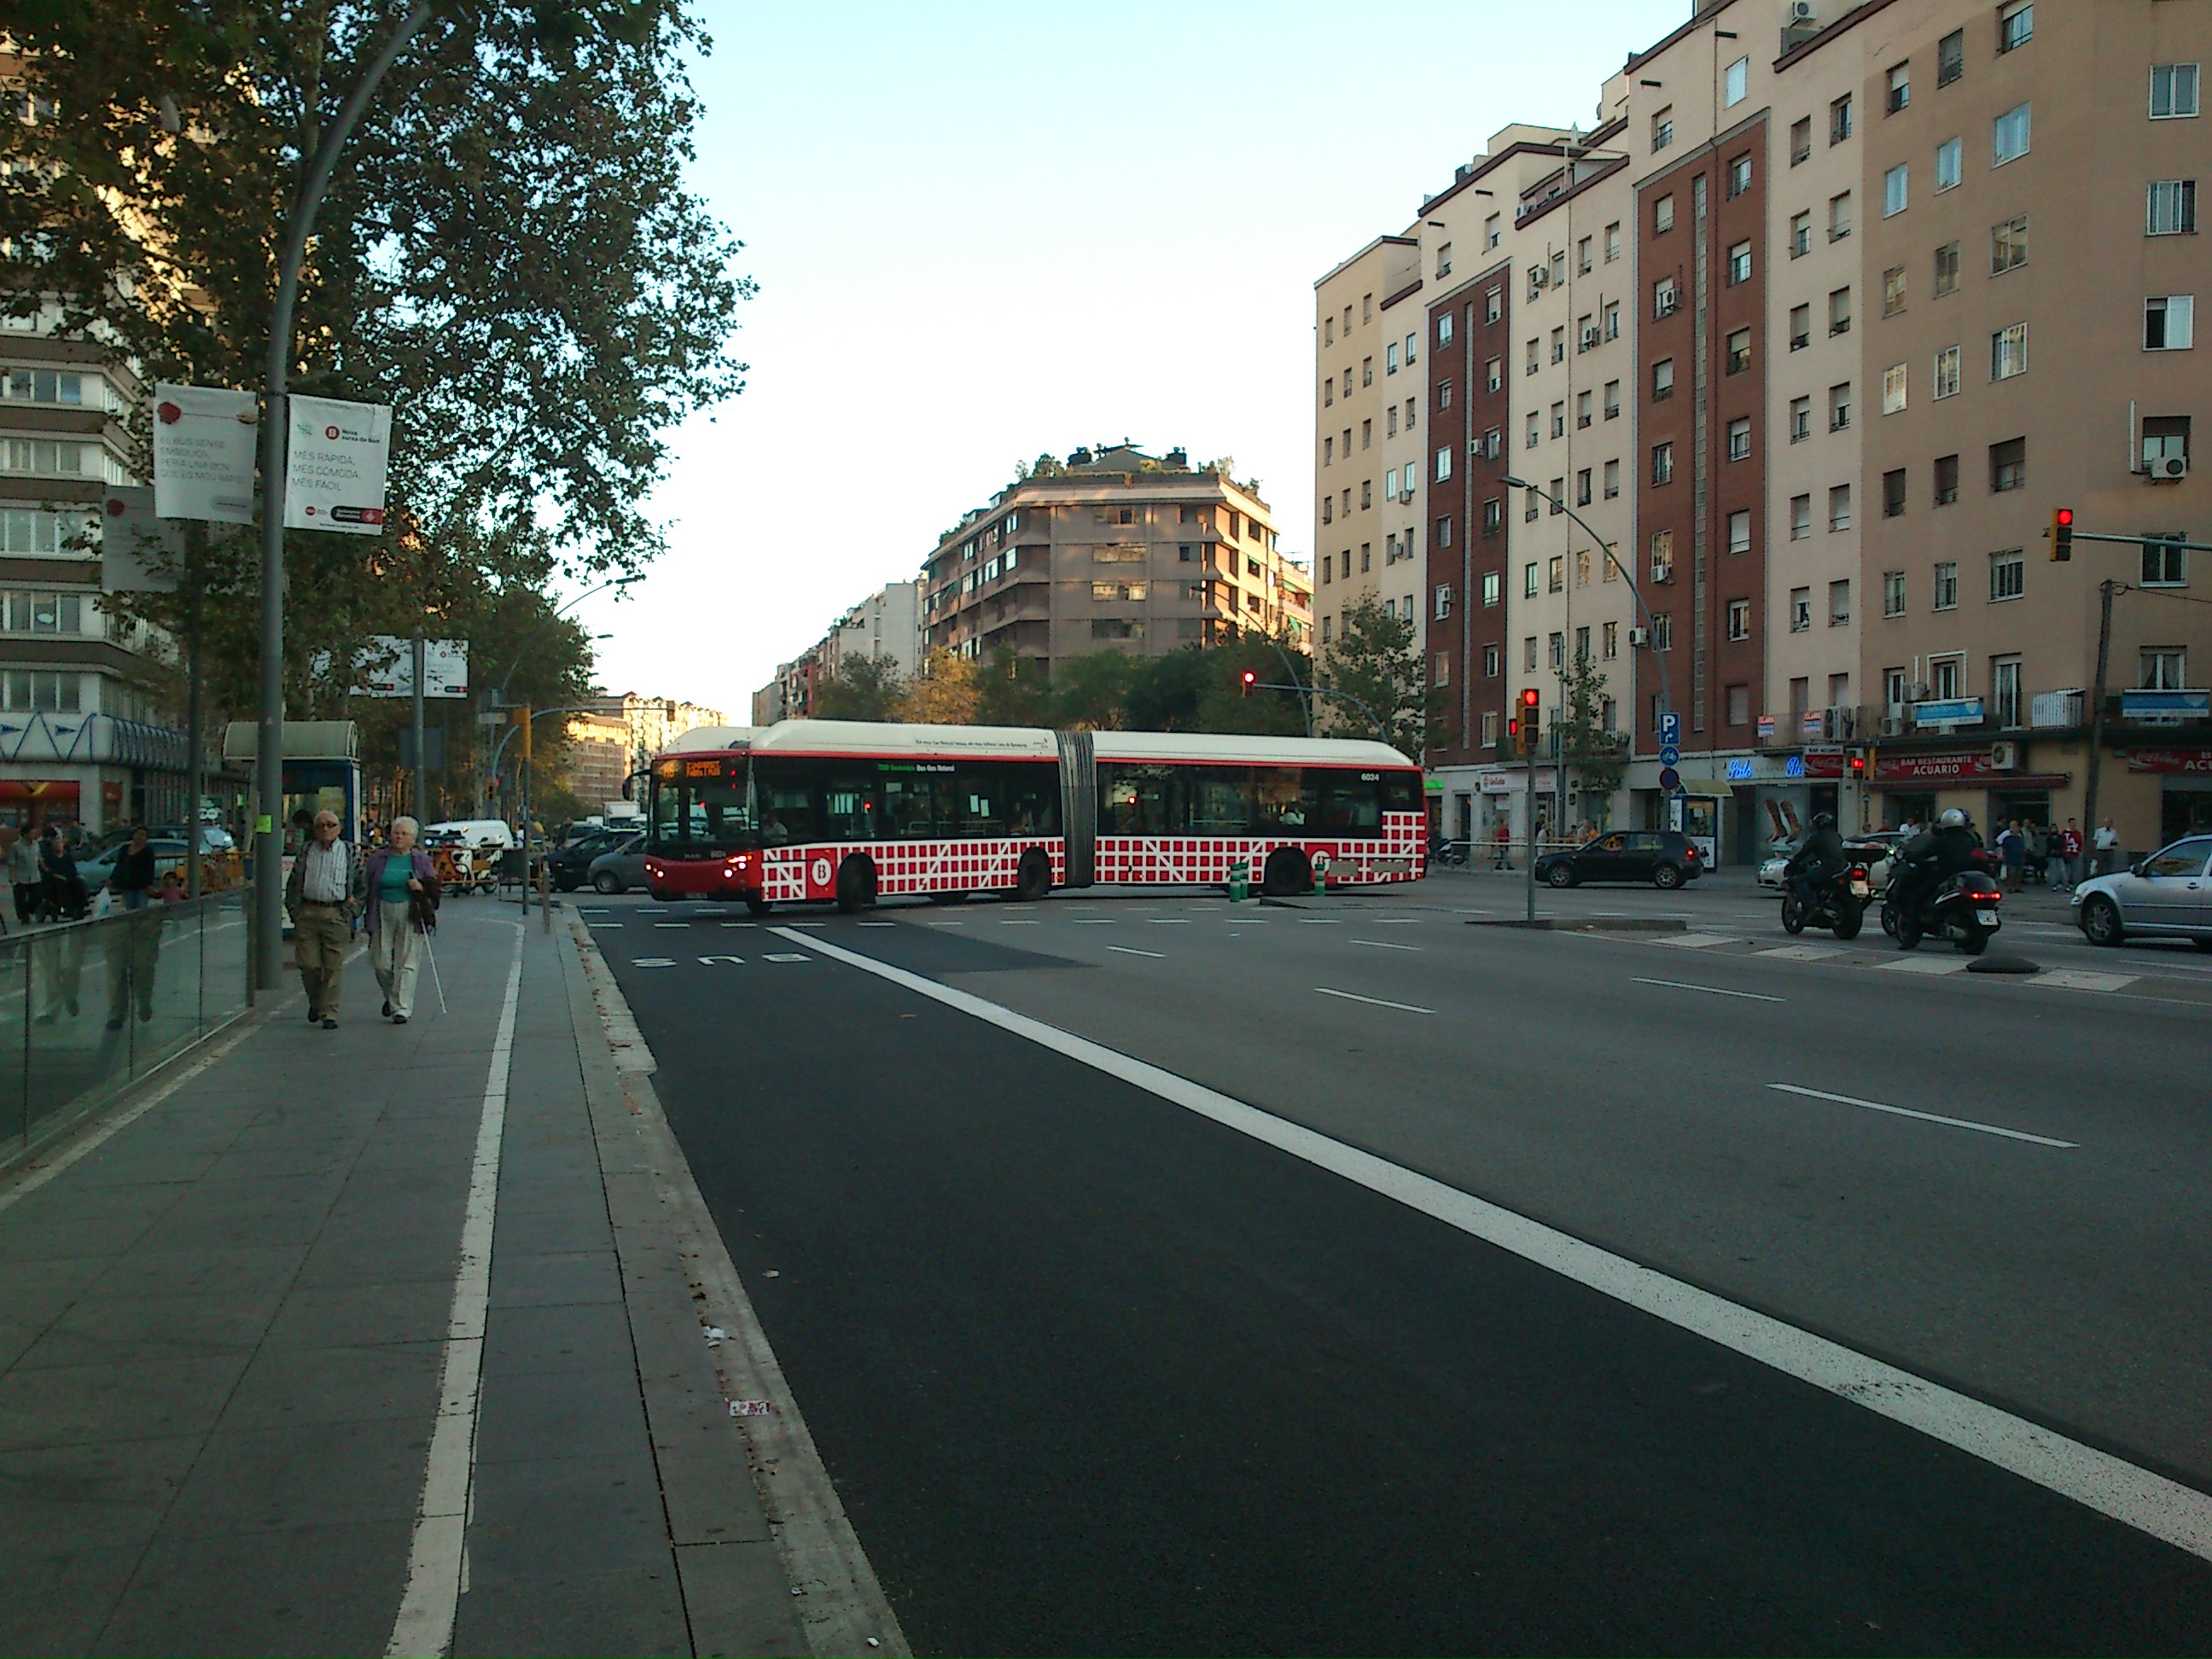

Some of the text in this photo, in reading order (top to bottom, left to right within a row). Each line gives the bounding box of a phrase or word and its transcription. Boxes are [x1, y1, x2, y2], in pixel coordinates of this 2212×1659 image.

[1662, 715, 1675, 732] P
[1901, 758, 1916, 766] BAR
[1918, 755, 1972, 765] RESTAURANTE
[1912, 764, 1960, 776] ACUARIO
